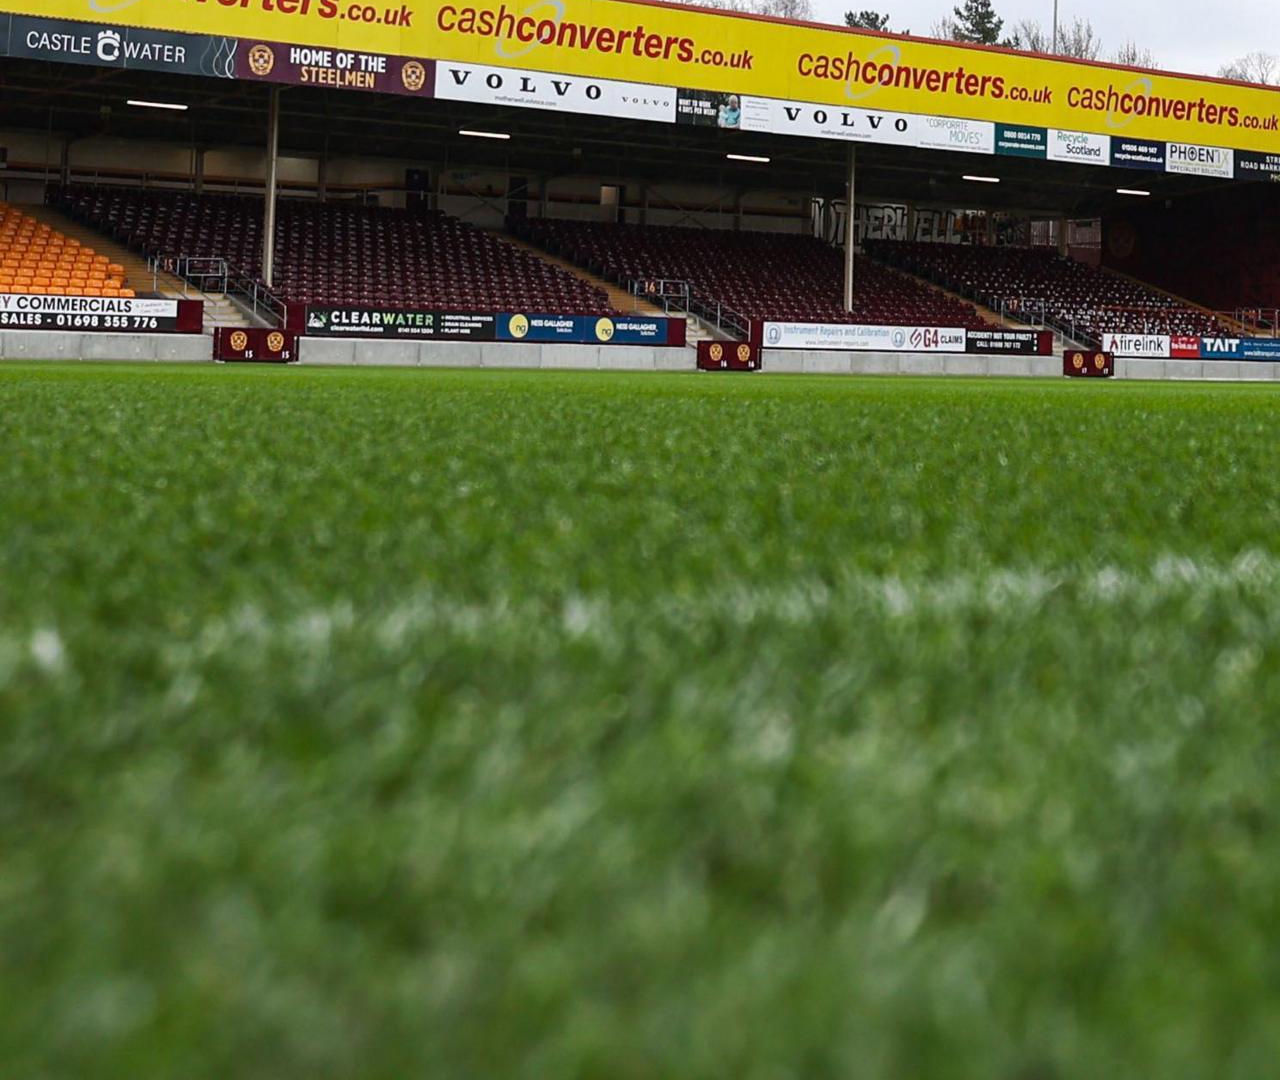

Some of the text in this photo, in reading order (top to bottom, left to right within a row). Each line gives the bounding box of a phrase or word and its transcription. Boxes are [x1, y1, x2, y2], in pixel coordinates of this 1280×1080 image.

[437, 5, 753, 69] cashconverters.co.uk
[27, 31, 186, 63] CASTLE WATER
[290, 48, 386, 73] HOME OF THE
[301, 66, 375, 88] STEELMEN
[449, 69, 602, 100] VOLVO
[798, 51, 1052, 105] cashconverters.co.uk
[622, 96, 670, 107] VOLVO
[1067, 85, 1279, 130] cashconverters.co.uk
[784, 107, 908, 132] VOLVO
[1057, 131, 1089, 145] Recycle
[1066, 144, 1100, 157] Scotland
[1170, 144, 1229, 164] PHOENIX
[1240, 161, 1258, 170] ROAD
[163, 258, 173, 270] 15
[645, 281, 656, 293] 16
[17, 296, 132, 313] COMMERCIALS
[1, 313, 42, 326] SALES
[56, 314, 98, 327] 01698
[104, 316, 128, 328] 355
[133, 317, 158, 329] 776
[331, 311, 434, 326] CLEARWATER
[784, 325, 890, 338] Instrument Repairs and Calibration
[923, 329, 939, 348] G4
[941, 336, 963, 344] CLAIMS
[1119, 335, 1163, 351] firelink
[1203, 338, 1240, 352] TAIT
[282, 351, 290, 359] 15
